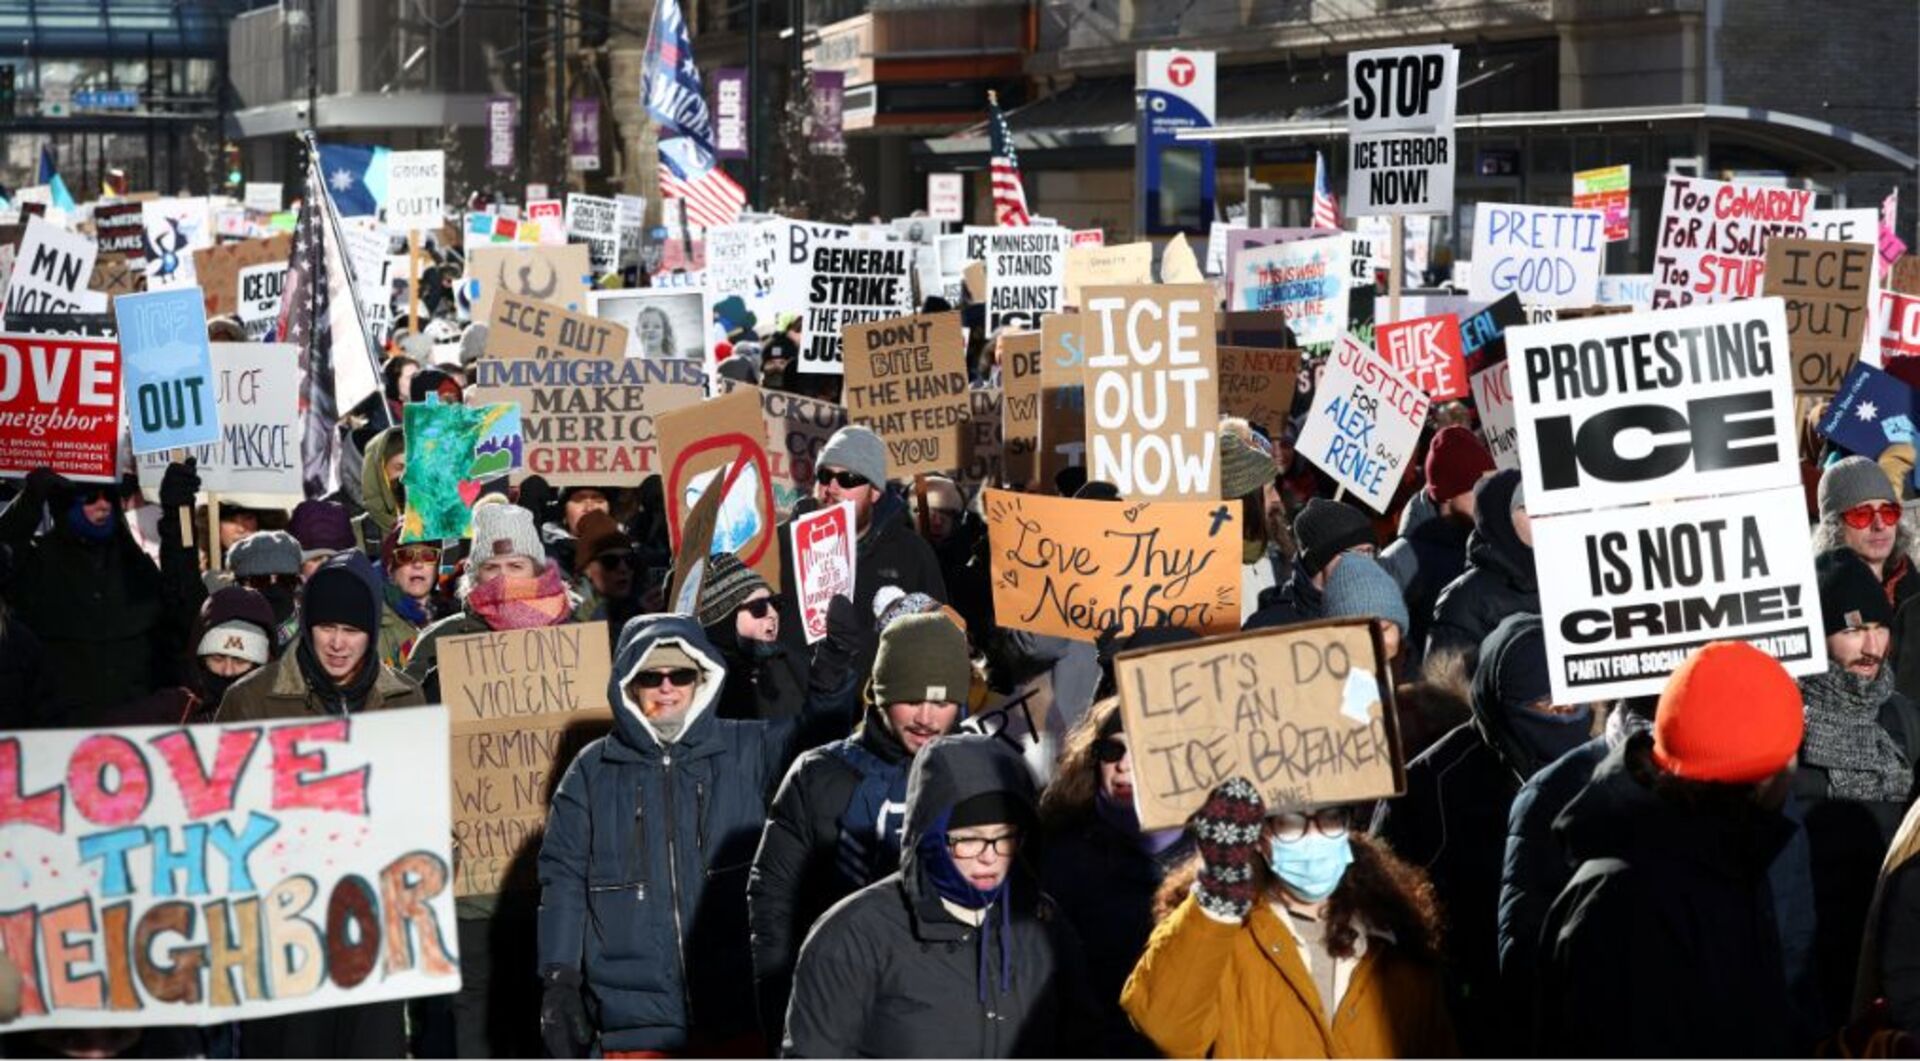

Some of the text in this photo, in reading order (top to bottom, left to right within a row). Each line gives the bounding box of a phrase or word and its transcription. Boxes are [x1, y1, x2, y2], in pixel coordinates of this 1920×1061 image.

[1354, 54, 1444, 120] STOP
[1354, 137, 1448, 170] ICE TERROR
[1370, 170, 1429, 206] NOW!
[966, 234, 987, 260] ICE
[990, 233, 1060, 253] MINNESOTA
[1488, 209, 1601, 252] PRETTI
[1705, 219, 1716, 250] A
[30, 243, 82, 293] MN
[813, 246, 906, 276] GENERAL
[998, 255, 1052, 276] STANDS
[1491, 256, 1577, 296] GOOD
[1694, 254, 1767, 297] STUP
[1781, 250, 1866, 291] ICE
[243, 273, 264, 302] ICE
[809, 275, 904, 306] STRIKE:
[989, 286, 1058, 311] AGAINST
[499, 300, 612, 356] ICE OUT
[808, 307, 837, 332] THE
[866, 322, 933, 350] DON'T
[1089, 297, 1200, 367] ICE
[1881, 295, 1920, 346] LO
[0, 344, 115, 406] OVE
[477, 358, 704, 388] IMMIGRANTS
[870, 346, 933, 379] BITE
[1338, 338, 1427, 428] JUSTICE
[1524, 319, 1774, 404] PROTESTING
[138, 376, 204, 434] OUT
[531, 386, 645, 412] MAKE
[849, 372, 966, 409] THE HAND
[1094, 367, 1210, 430] OUT
[1351, 384, 1378, 421] FOR
[520, 415, 657, 442] MERIC
[852, 403, 972, 435] THAT FEEDS
[1324, 396, 1376, 448] ALEX
[1534, 389, 1780, 491] ICE
[224, 423, 294, 469] MAKOCE
[528, 446, 657, 473] GREAT
[887, 436, 939, 466] YOU
[1093, 431, 1216, 495] NOW
[1325, 434, 1387, 496] RENEE
[1006, 517, 1217, 600] Love Thy
[1585, 515, 1770, 597] IS NOT A
[1021, 575, 1213, 632] Neighbor
[1560, 583, 1803, 645] CRIME!
[223, 635, 245, 651] M
[448, 628, 581, 677] THE ONLY
[1136, 640, 1351, 720] LET'S DO
[1567, 659, 1611, 682] PARTY
[1612, 657, 1639, 677] FOR
[1641, 649, 1690, 673] SOCIAL
[463, 671, 580, 719] VIOLENT
[1235, 687, 1280, 733] AN
[466, 729, 561, 770] CRIMIN
[1149, 715, 1391, 798] ICE BREAKER
[0, 718, 371, 835] LOVE
[454, 770, 547, 815] WE NE
[78, 811, 281, 898] THY
